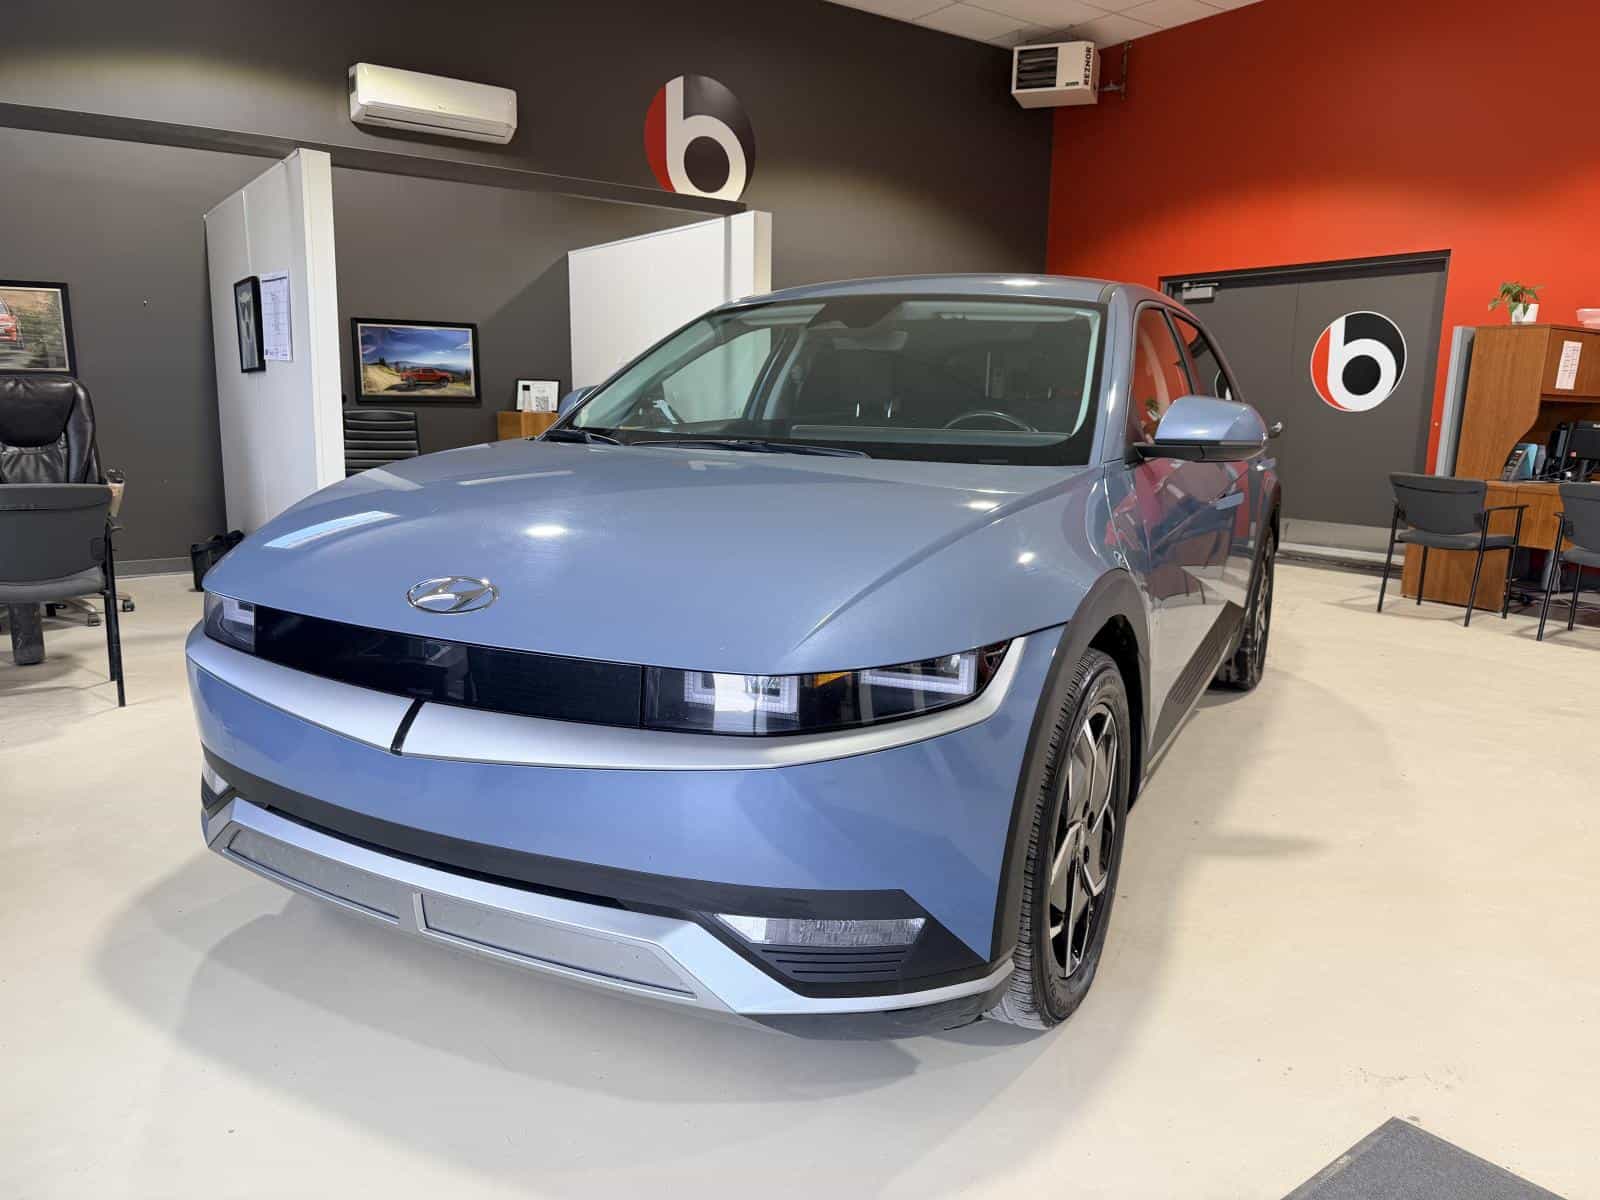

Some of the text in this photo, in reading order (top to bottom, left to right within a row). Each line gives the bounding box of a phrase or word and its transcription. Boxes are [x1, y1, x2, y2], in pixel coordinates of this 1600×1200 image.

[1083, 46, 1092, 86] REZNOR
[665, 75, 747, 201] b
[1327, 314, 1397, 411] b
